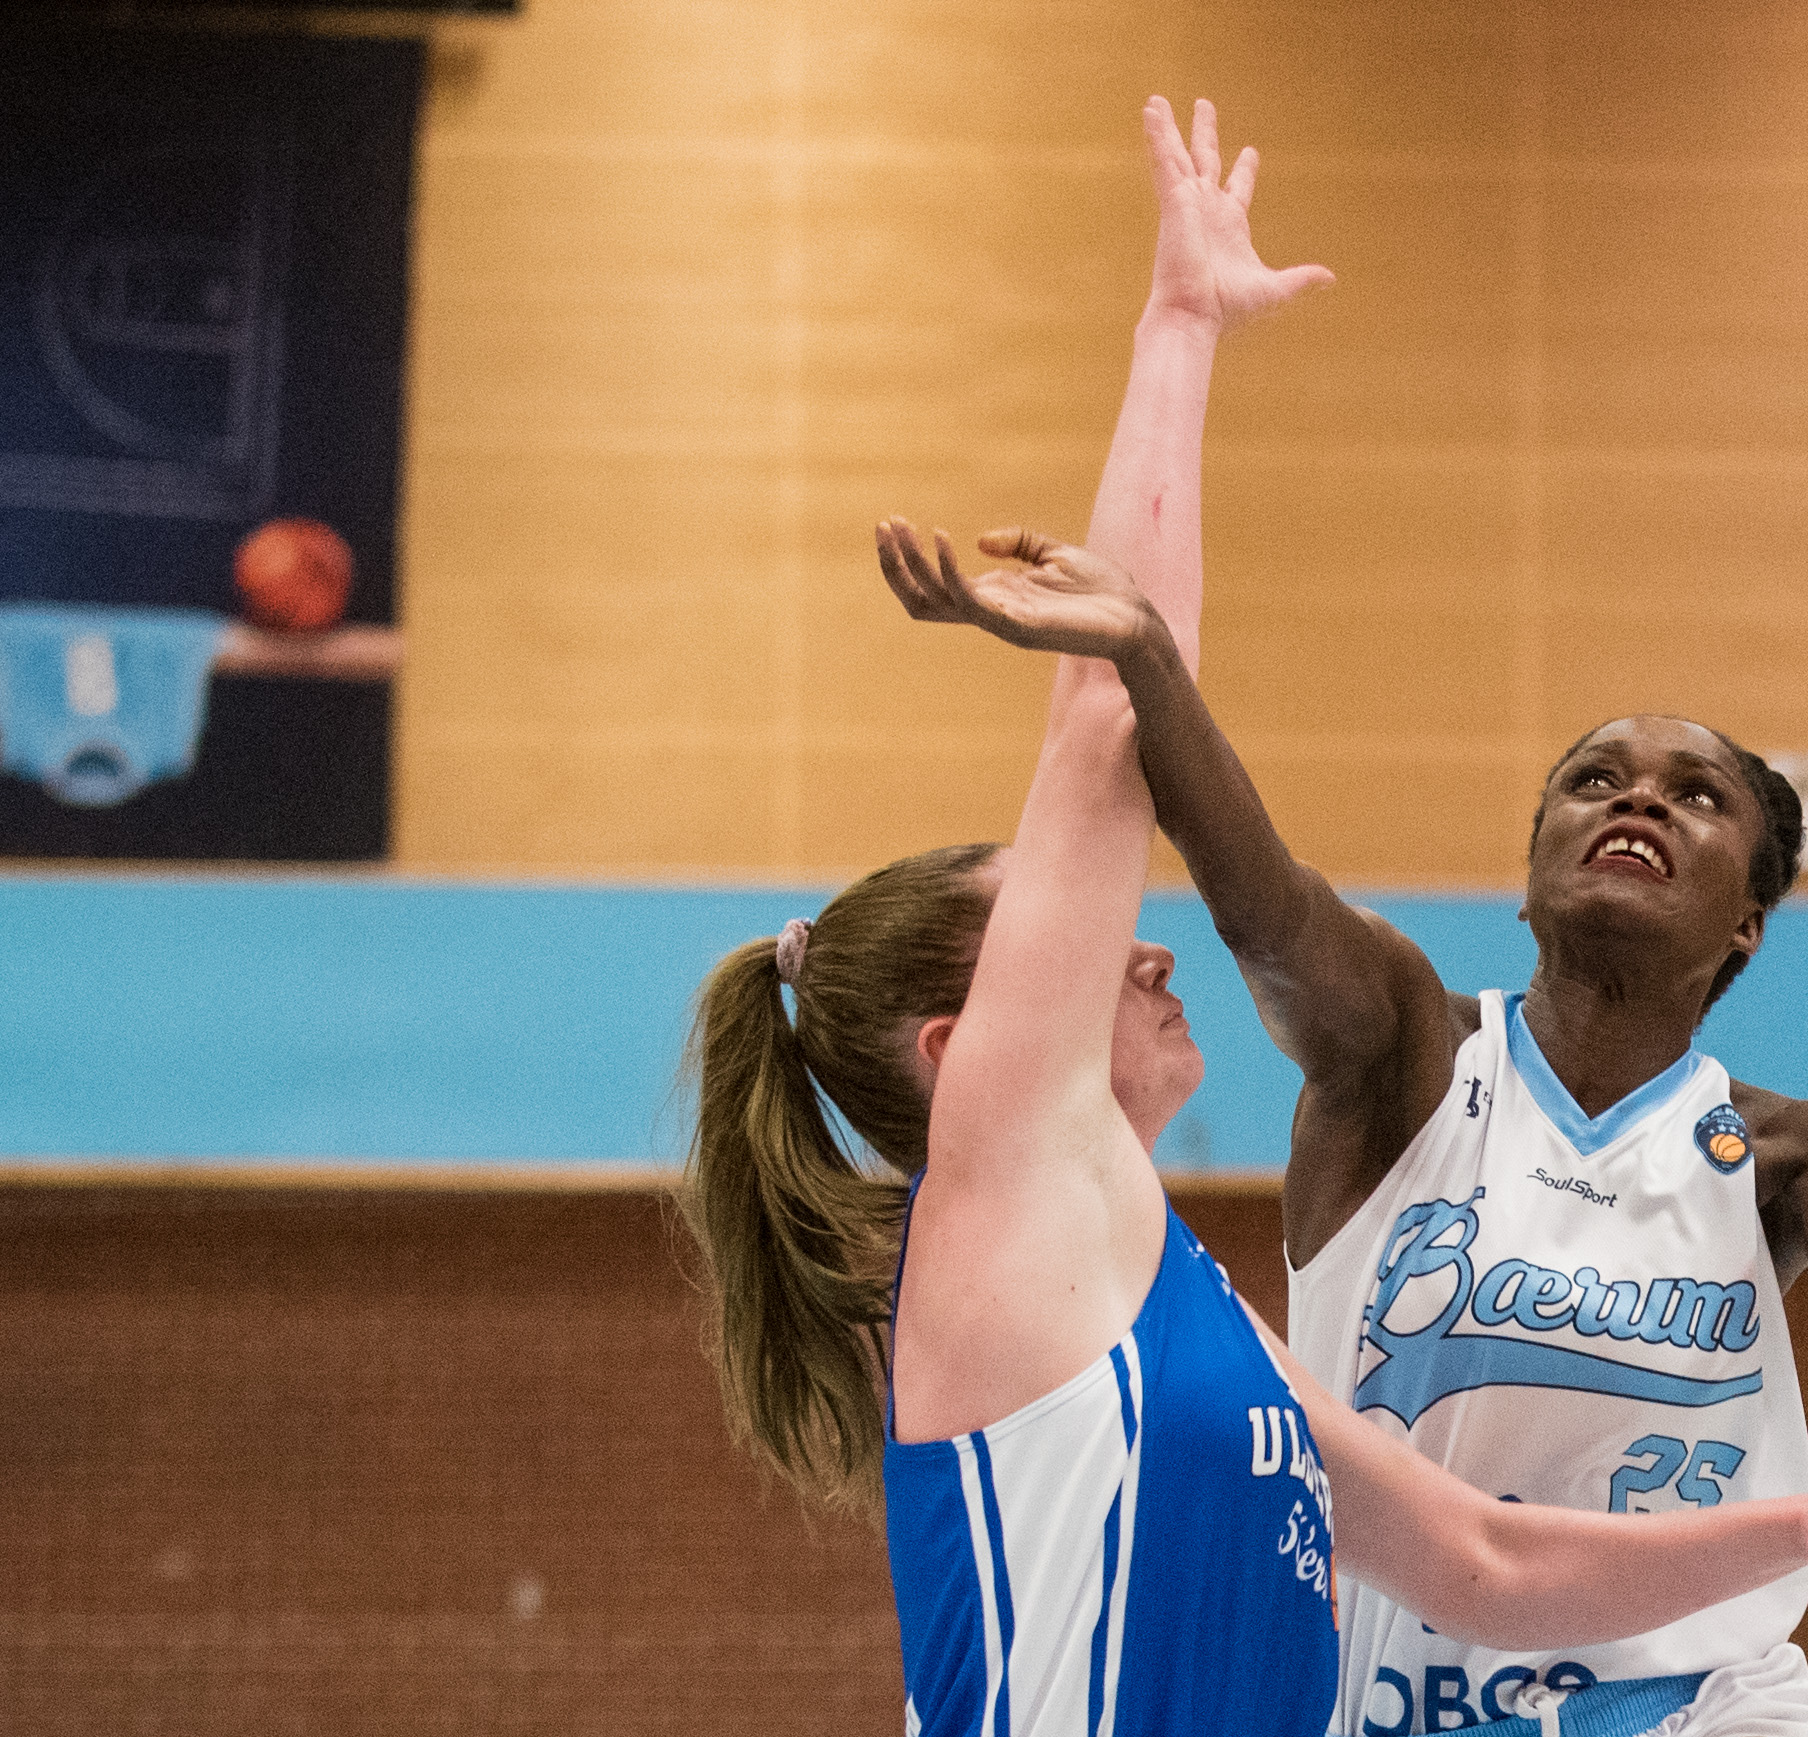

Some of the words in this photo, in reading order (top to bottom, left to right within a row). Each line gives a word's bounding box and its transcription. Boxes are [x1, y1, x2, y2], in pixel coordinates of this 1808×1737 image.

[1527, 1167, 1618, 1208] SoulSport
[1362, 1187, 1760, 1352] Bærum
[1608, 1433, 1747, 1514] 25
